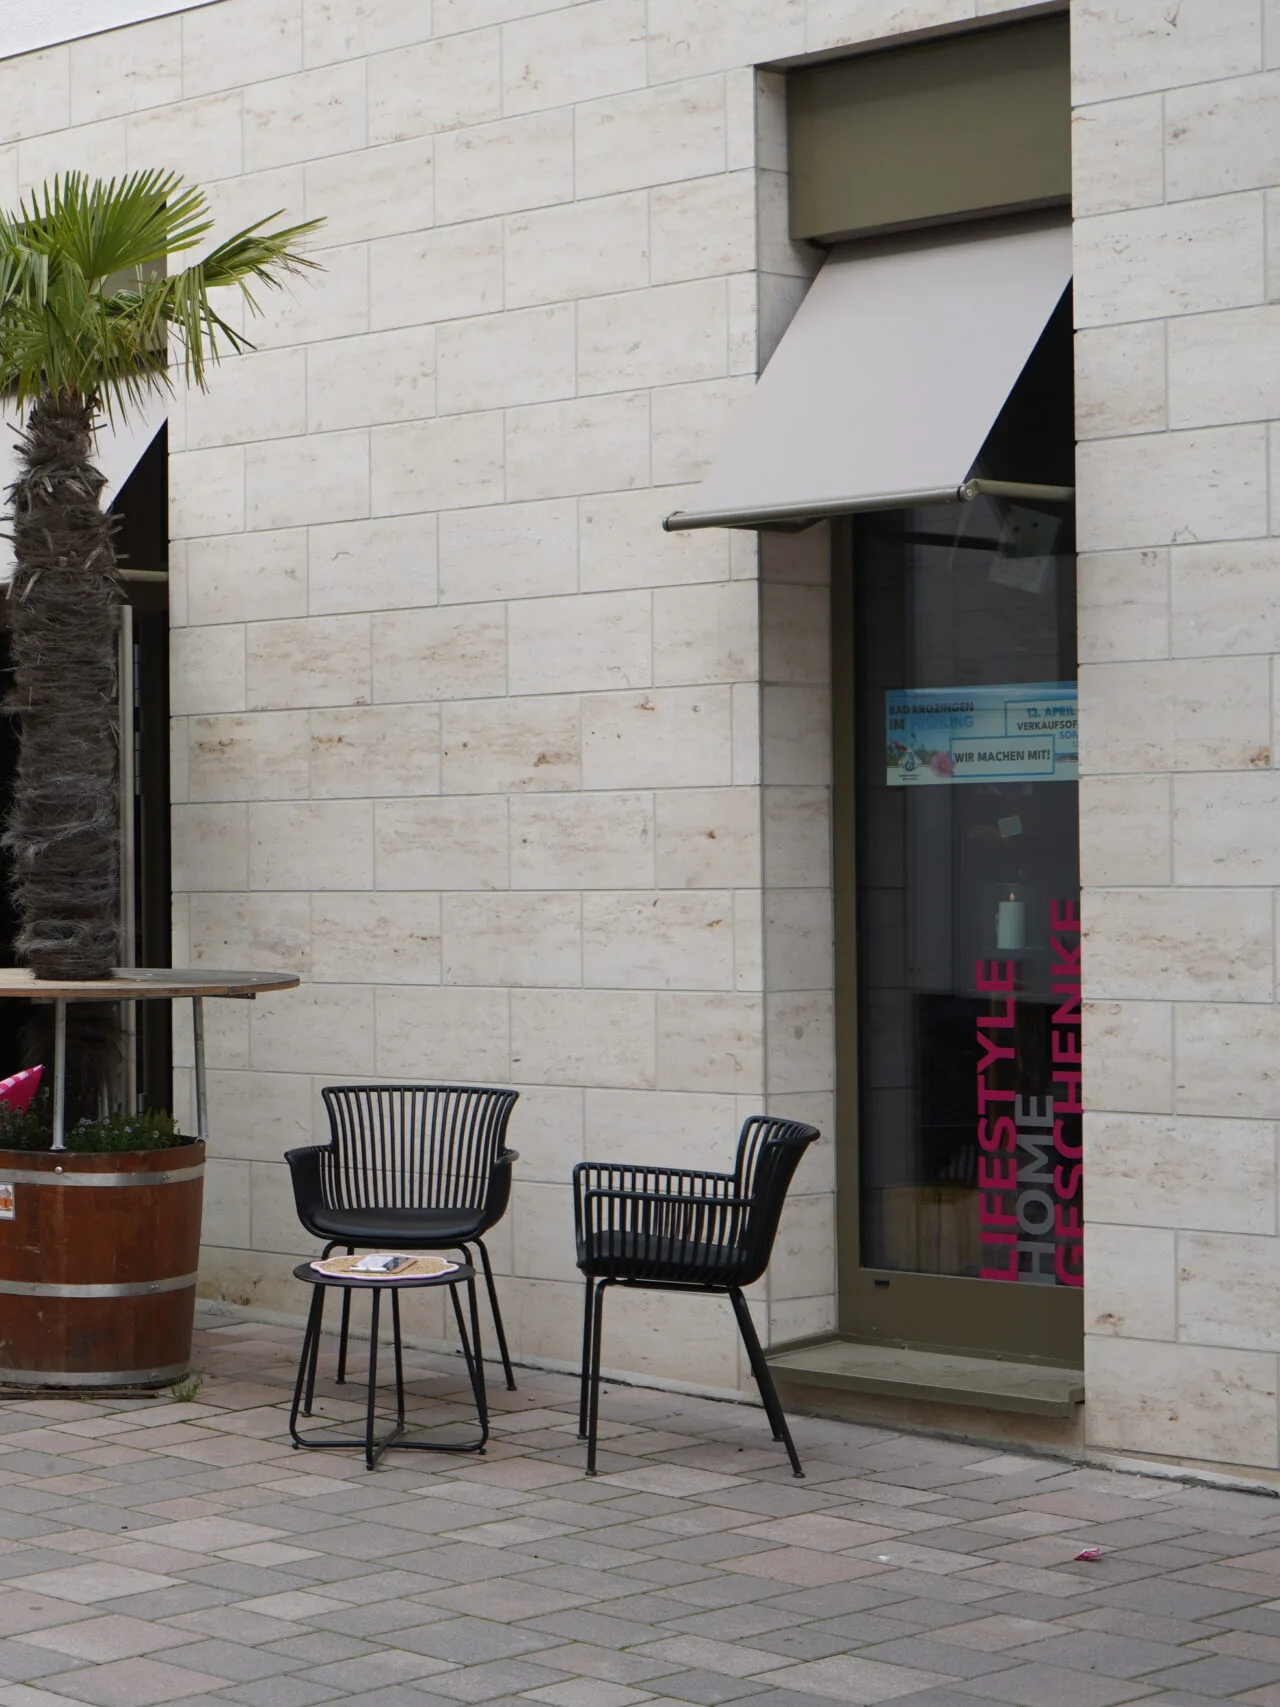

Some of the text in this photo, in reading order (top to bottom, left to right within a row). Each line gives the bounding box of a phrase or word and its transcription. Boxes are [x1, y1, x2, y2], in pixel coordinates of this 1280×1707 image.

[889, 705, 910, 716] BAD
[1026, 705, 1077, 719] 13. APRIL
[889, 718, 905, 730] IM
[954, 749, 1051, 763] WIR MACHEN MIT!
[976, 960, 1019, 1282] LIFESTYLE
[1015, 1094, 1057, 1286] HOME
